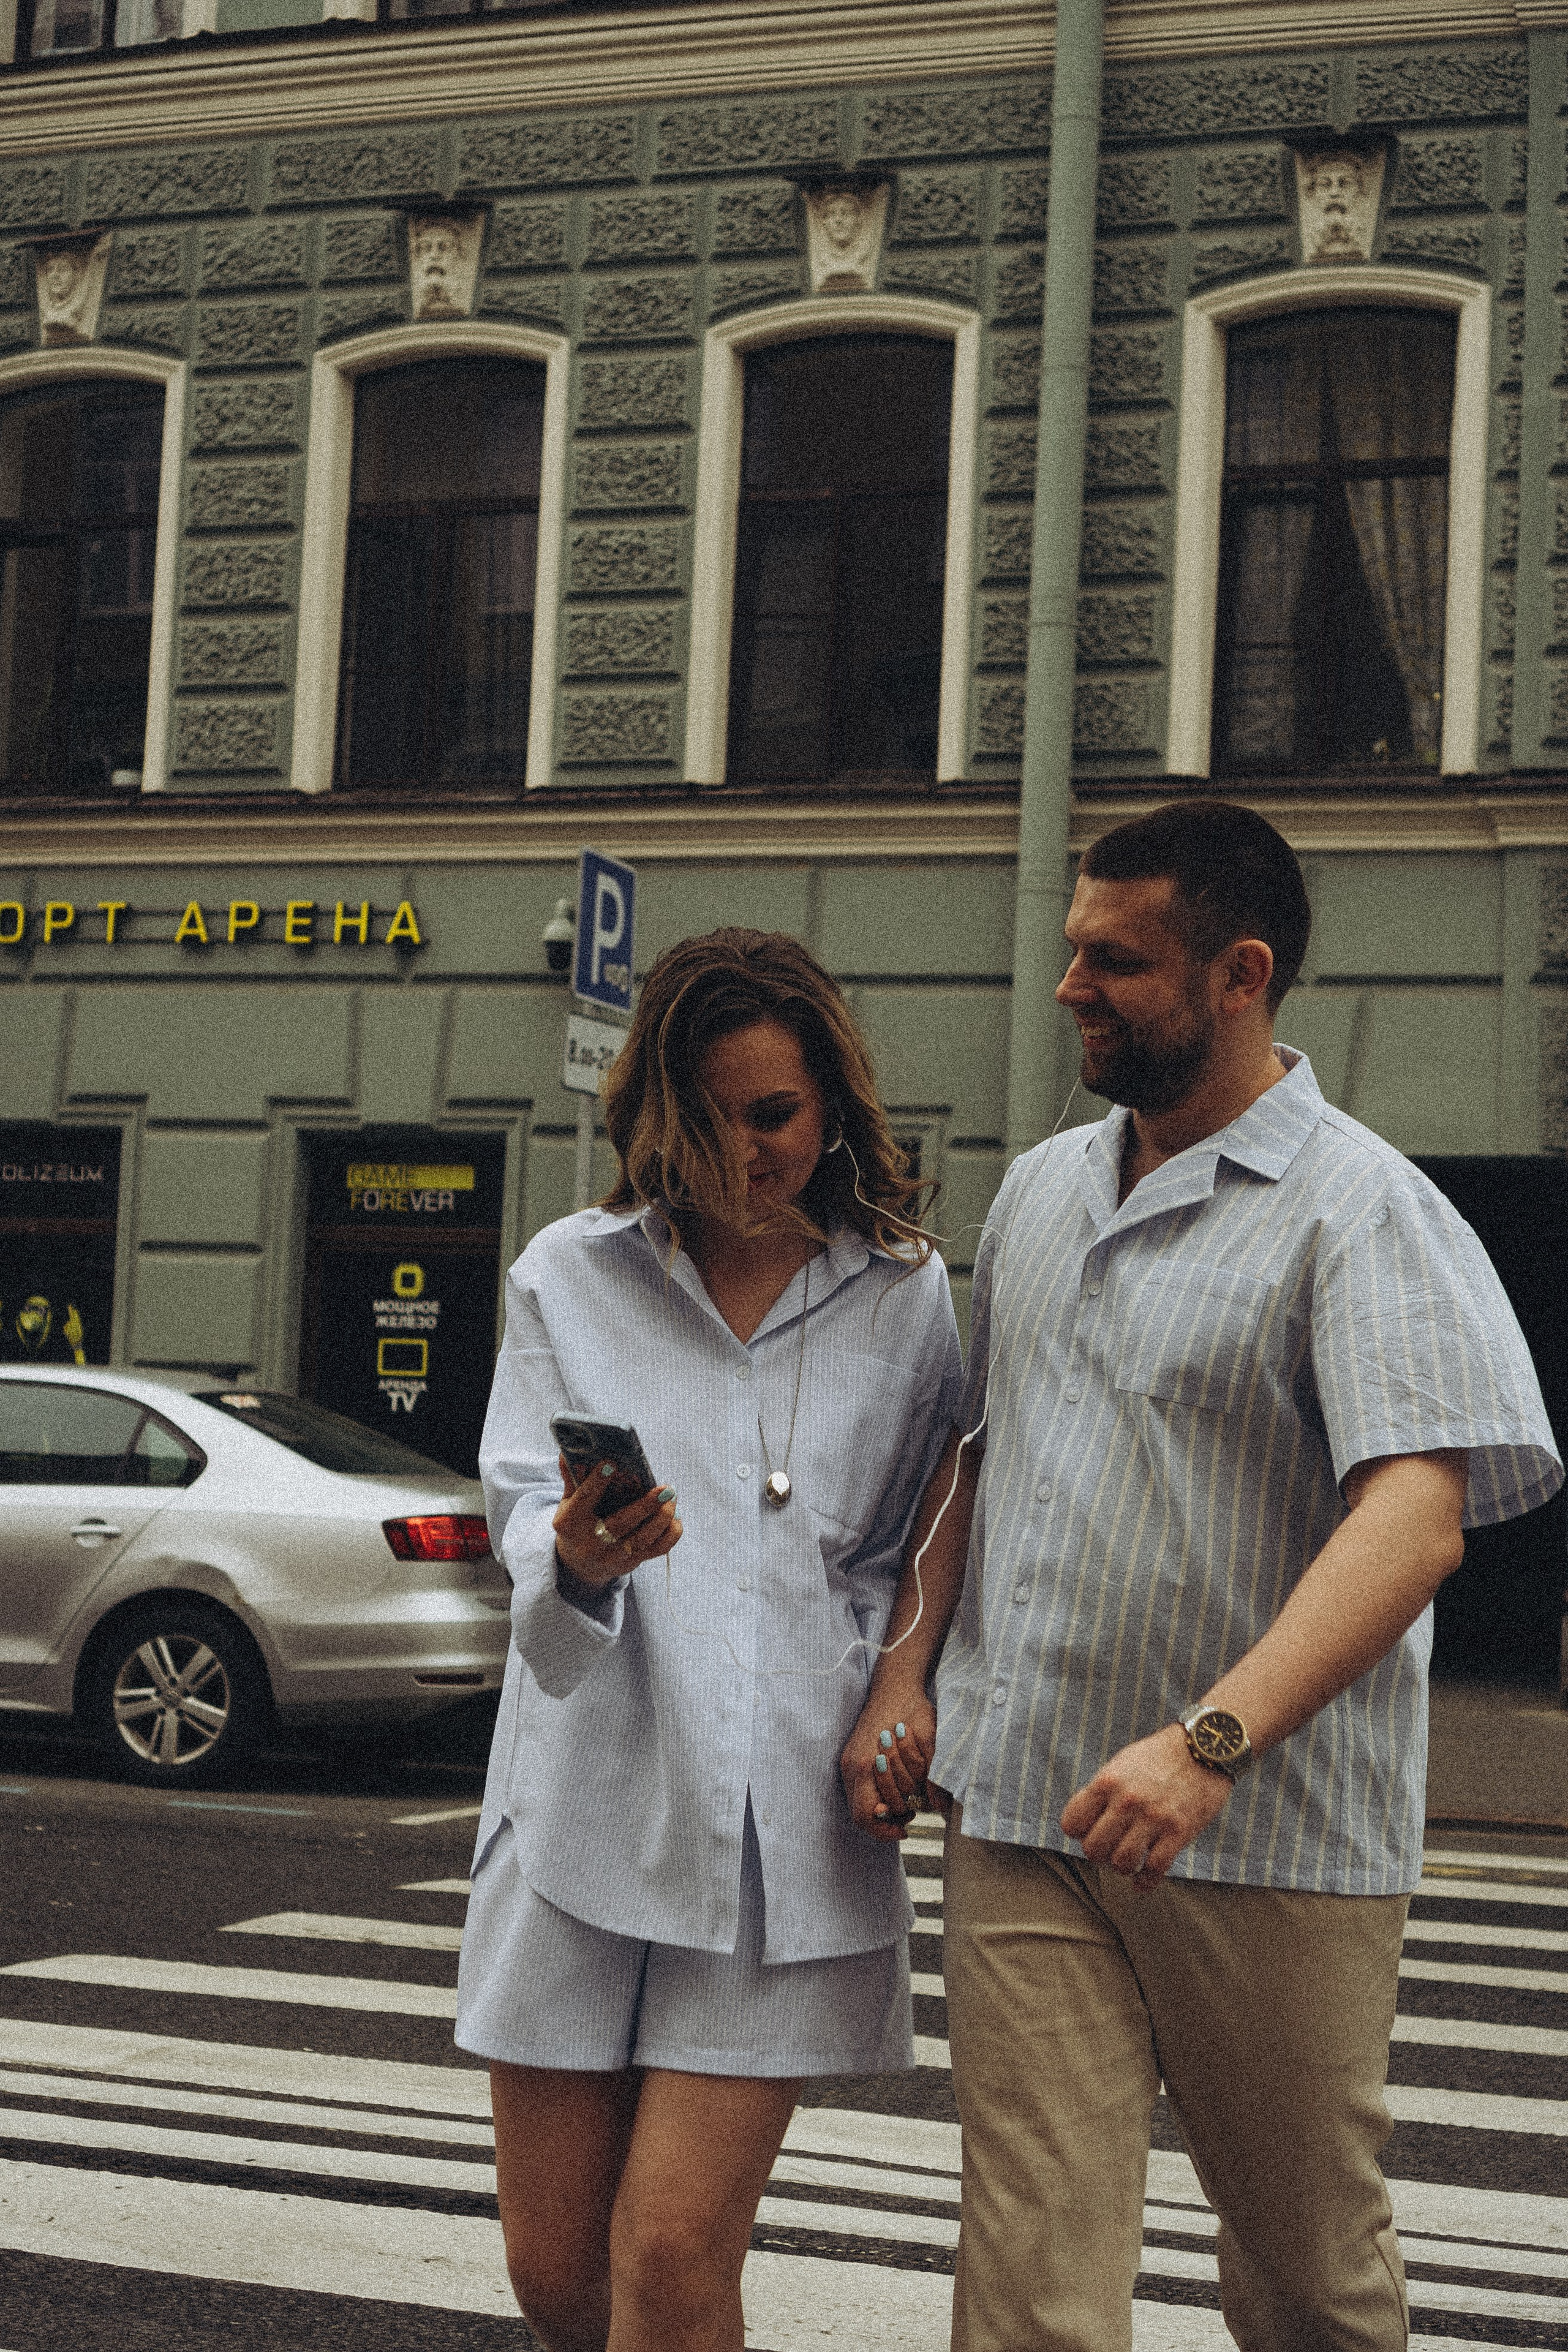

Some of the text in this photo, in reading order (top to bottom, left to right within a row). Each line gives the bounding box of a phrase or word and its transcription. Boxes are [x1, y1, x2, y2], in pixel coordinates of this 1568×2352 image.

[0, 900, 421, 944] ОРТ АРЕНА
[592, 872, 625, 985] P
[350, 1164, 417, 1188] GAME
[350, 1190, 454, 1212] FOREVER
[388, 1392, 418, 1412] TV
